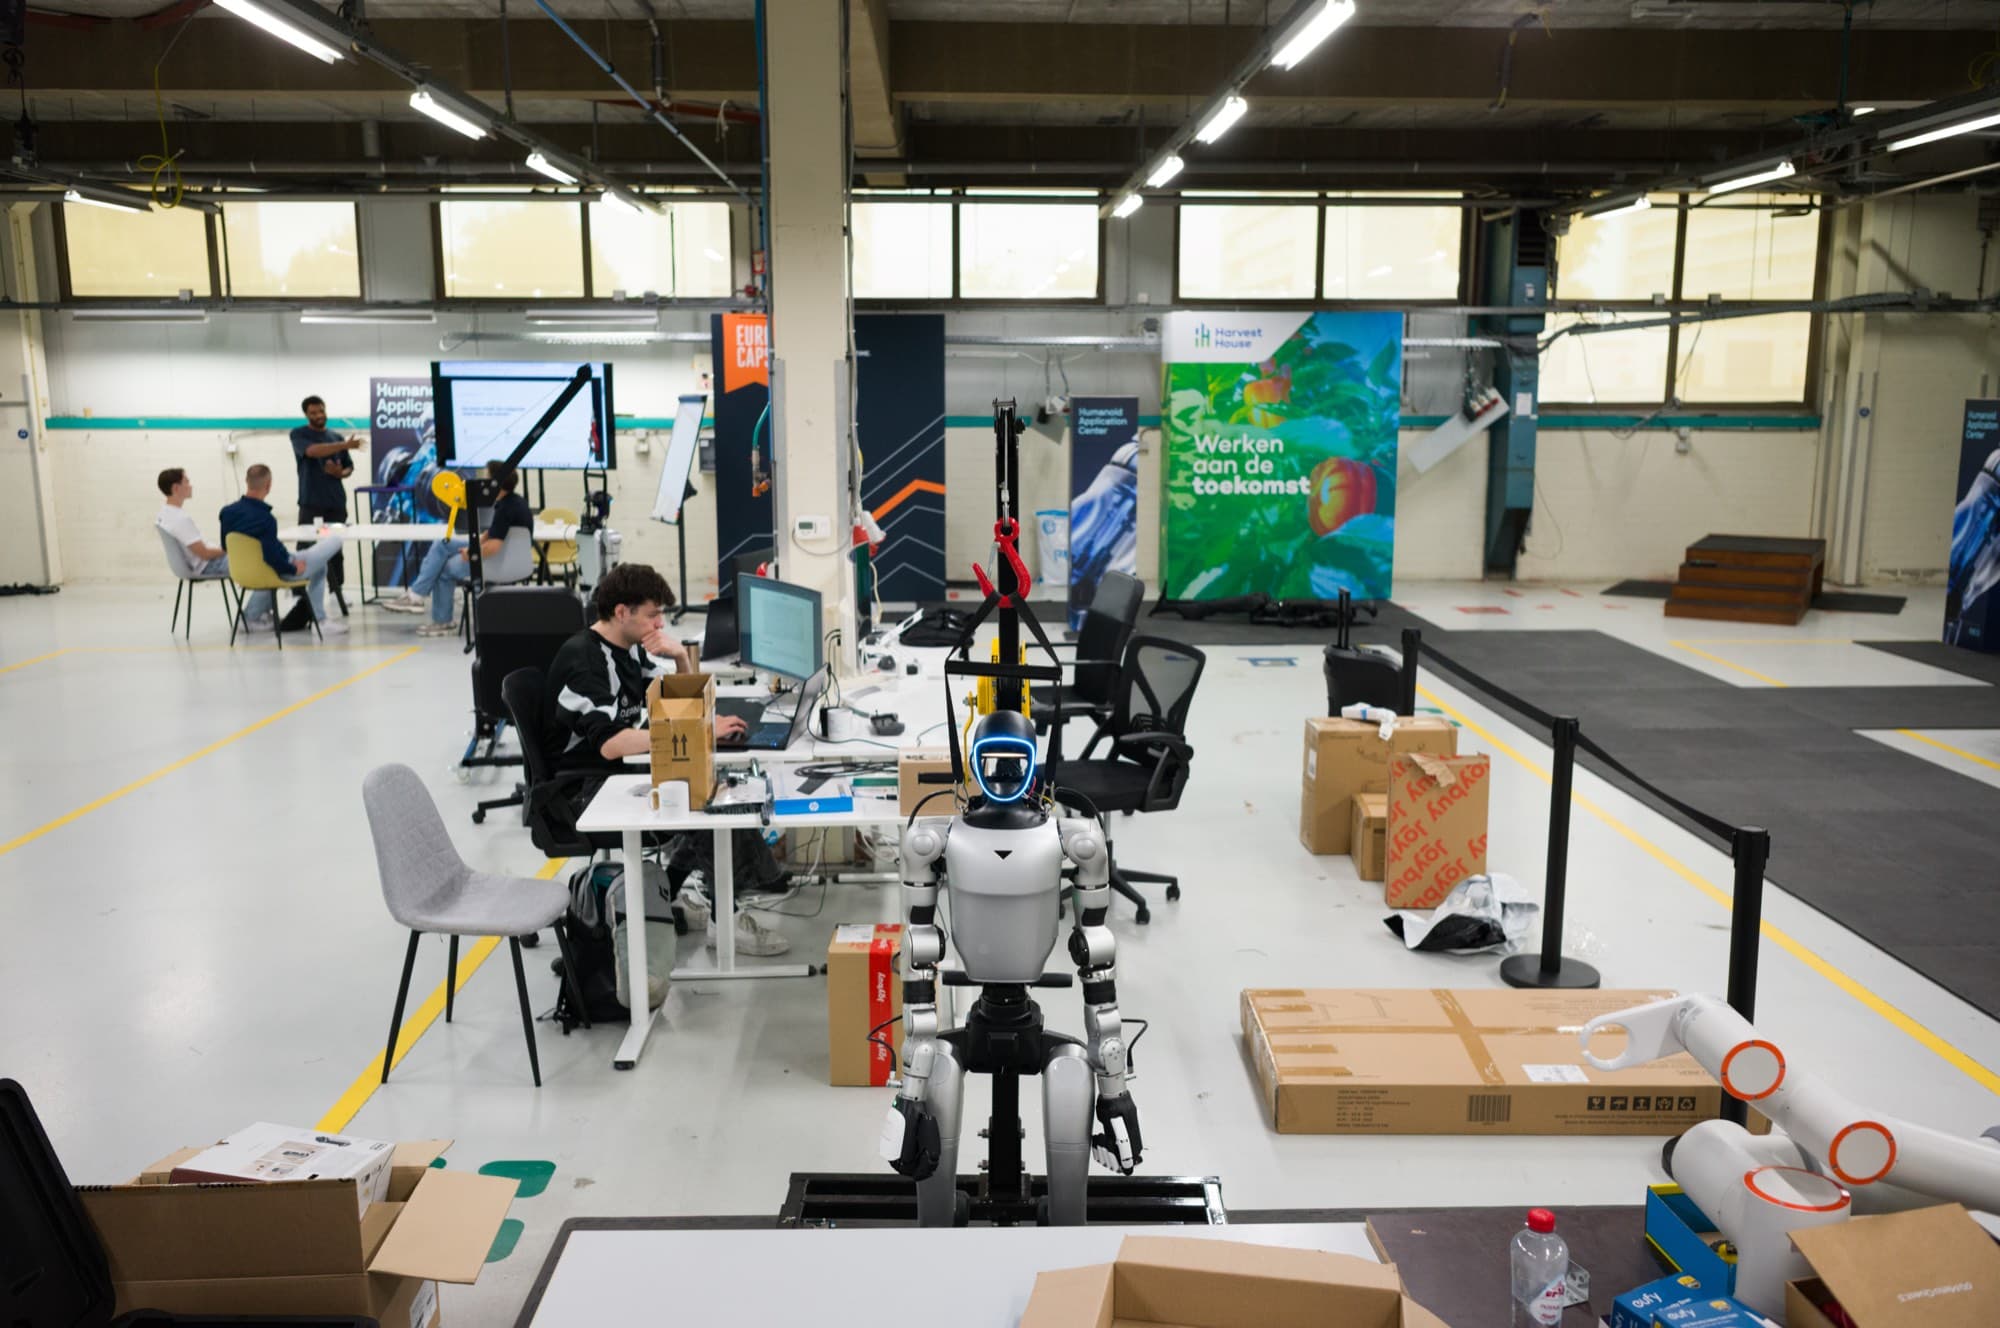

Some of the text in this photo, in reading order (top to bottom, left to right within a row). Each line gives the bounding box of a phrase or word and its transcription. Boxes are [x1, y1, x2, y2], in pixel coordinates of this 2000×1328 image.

[1215, 327, 1263, 338] Harvest
[1215, 338, 1253, 349] House
[1078, 407, 1124, 416] Humanoid
[376, 414, 425, 429] Center
[1078, 417, 1128, 427] Application
[1078, 426, 1108, 435] Center
[1193, 434, 1284, 455] Werken
[1192, 455, 1274, 475] aan de
[1192, 476, 1311, 496] toekomst
[1426, 763, 1489, 822] oybuy
[1632, 1291, 1662, 1308] eufy
